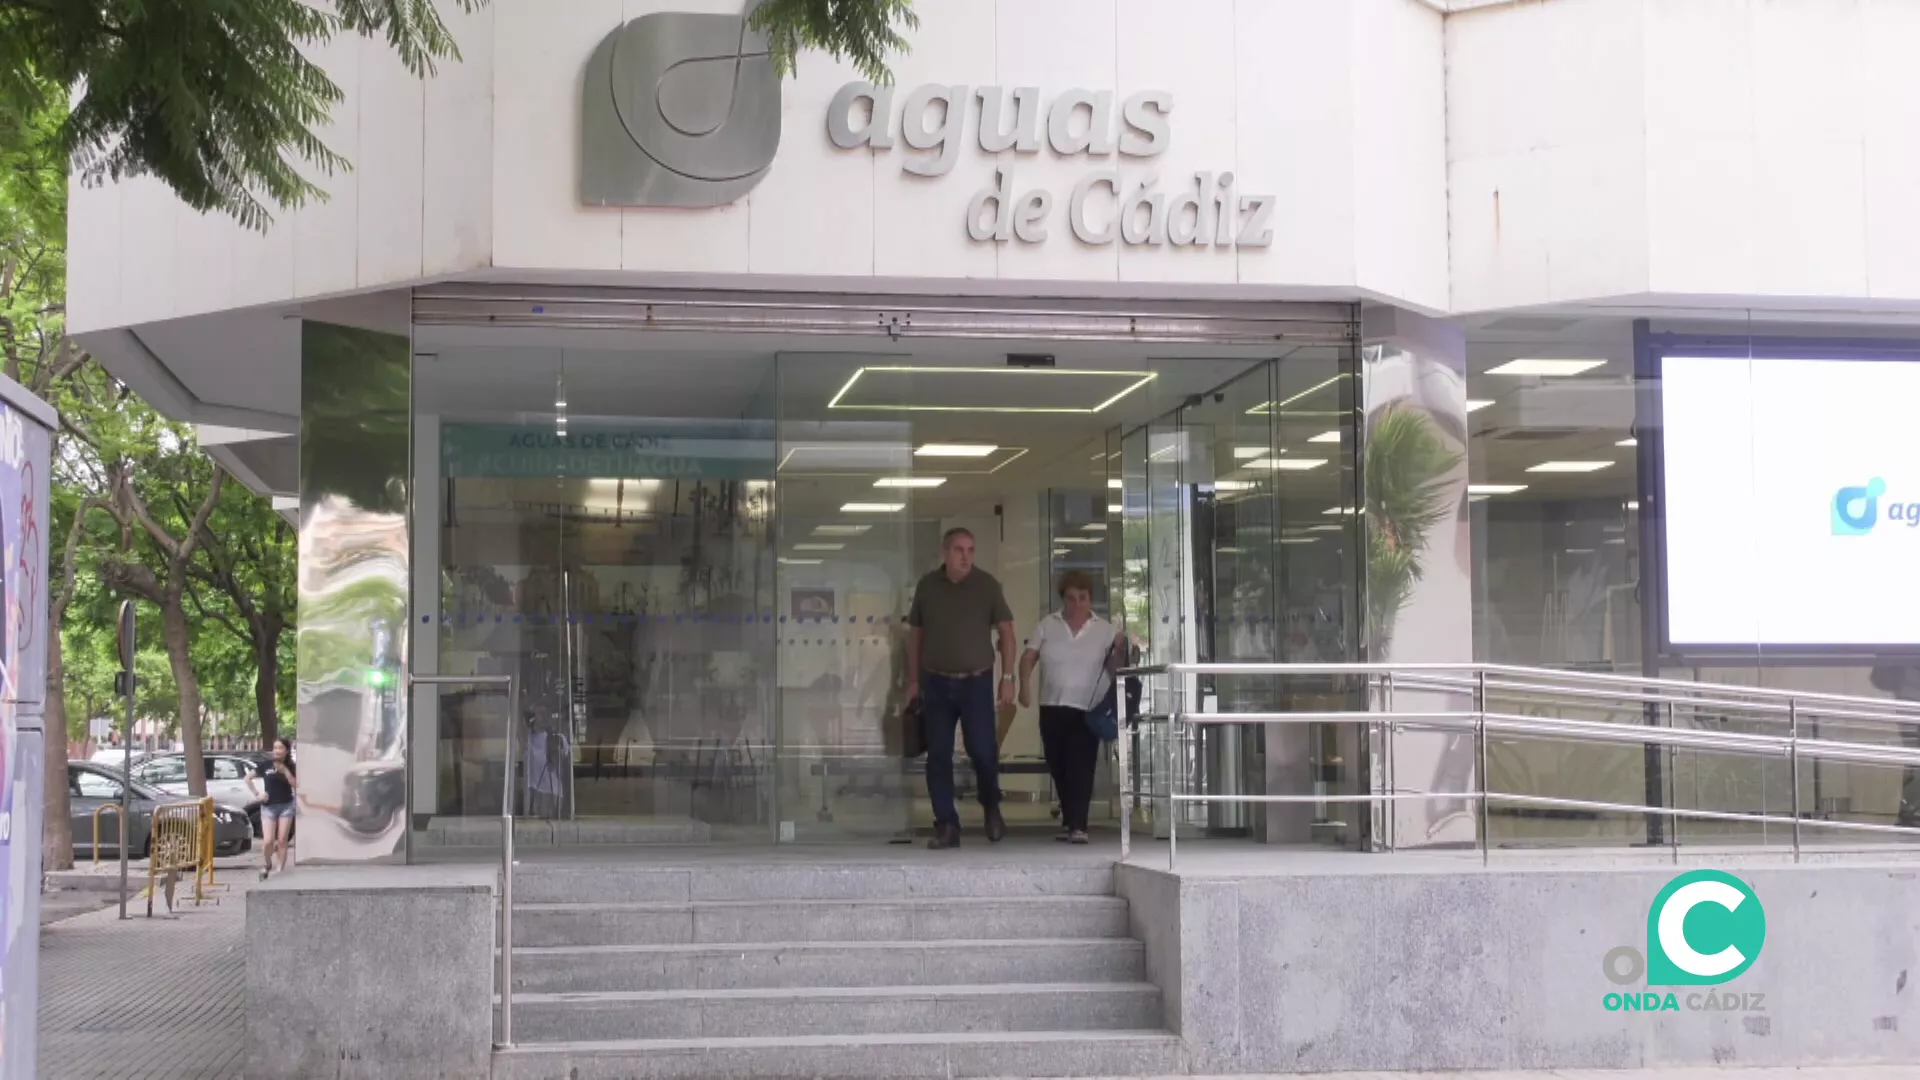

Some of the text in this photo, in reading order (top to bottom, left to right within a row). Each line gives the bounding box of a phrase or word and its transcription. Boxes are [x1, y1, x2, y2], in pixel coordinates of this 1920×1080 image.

[827, 80, 1174, 177] aguas
[967, 165, 1276, 248] de Cádiz
[581, 433, 607, 448] DE
